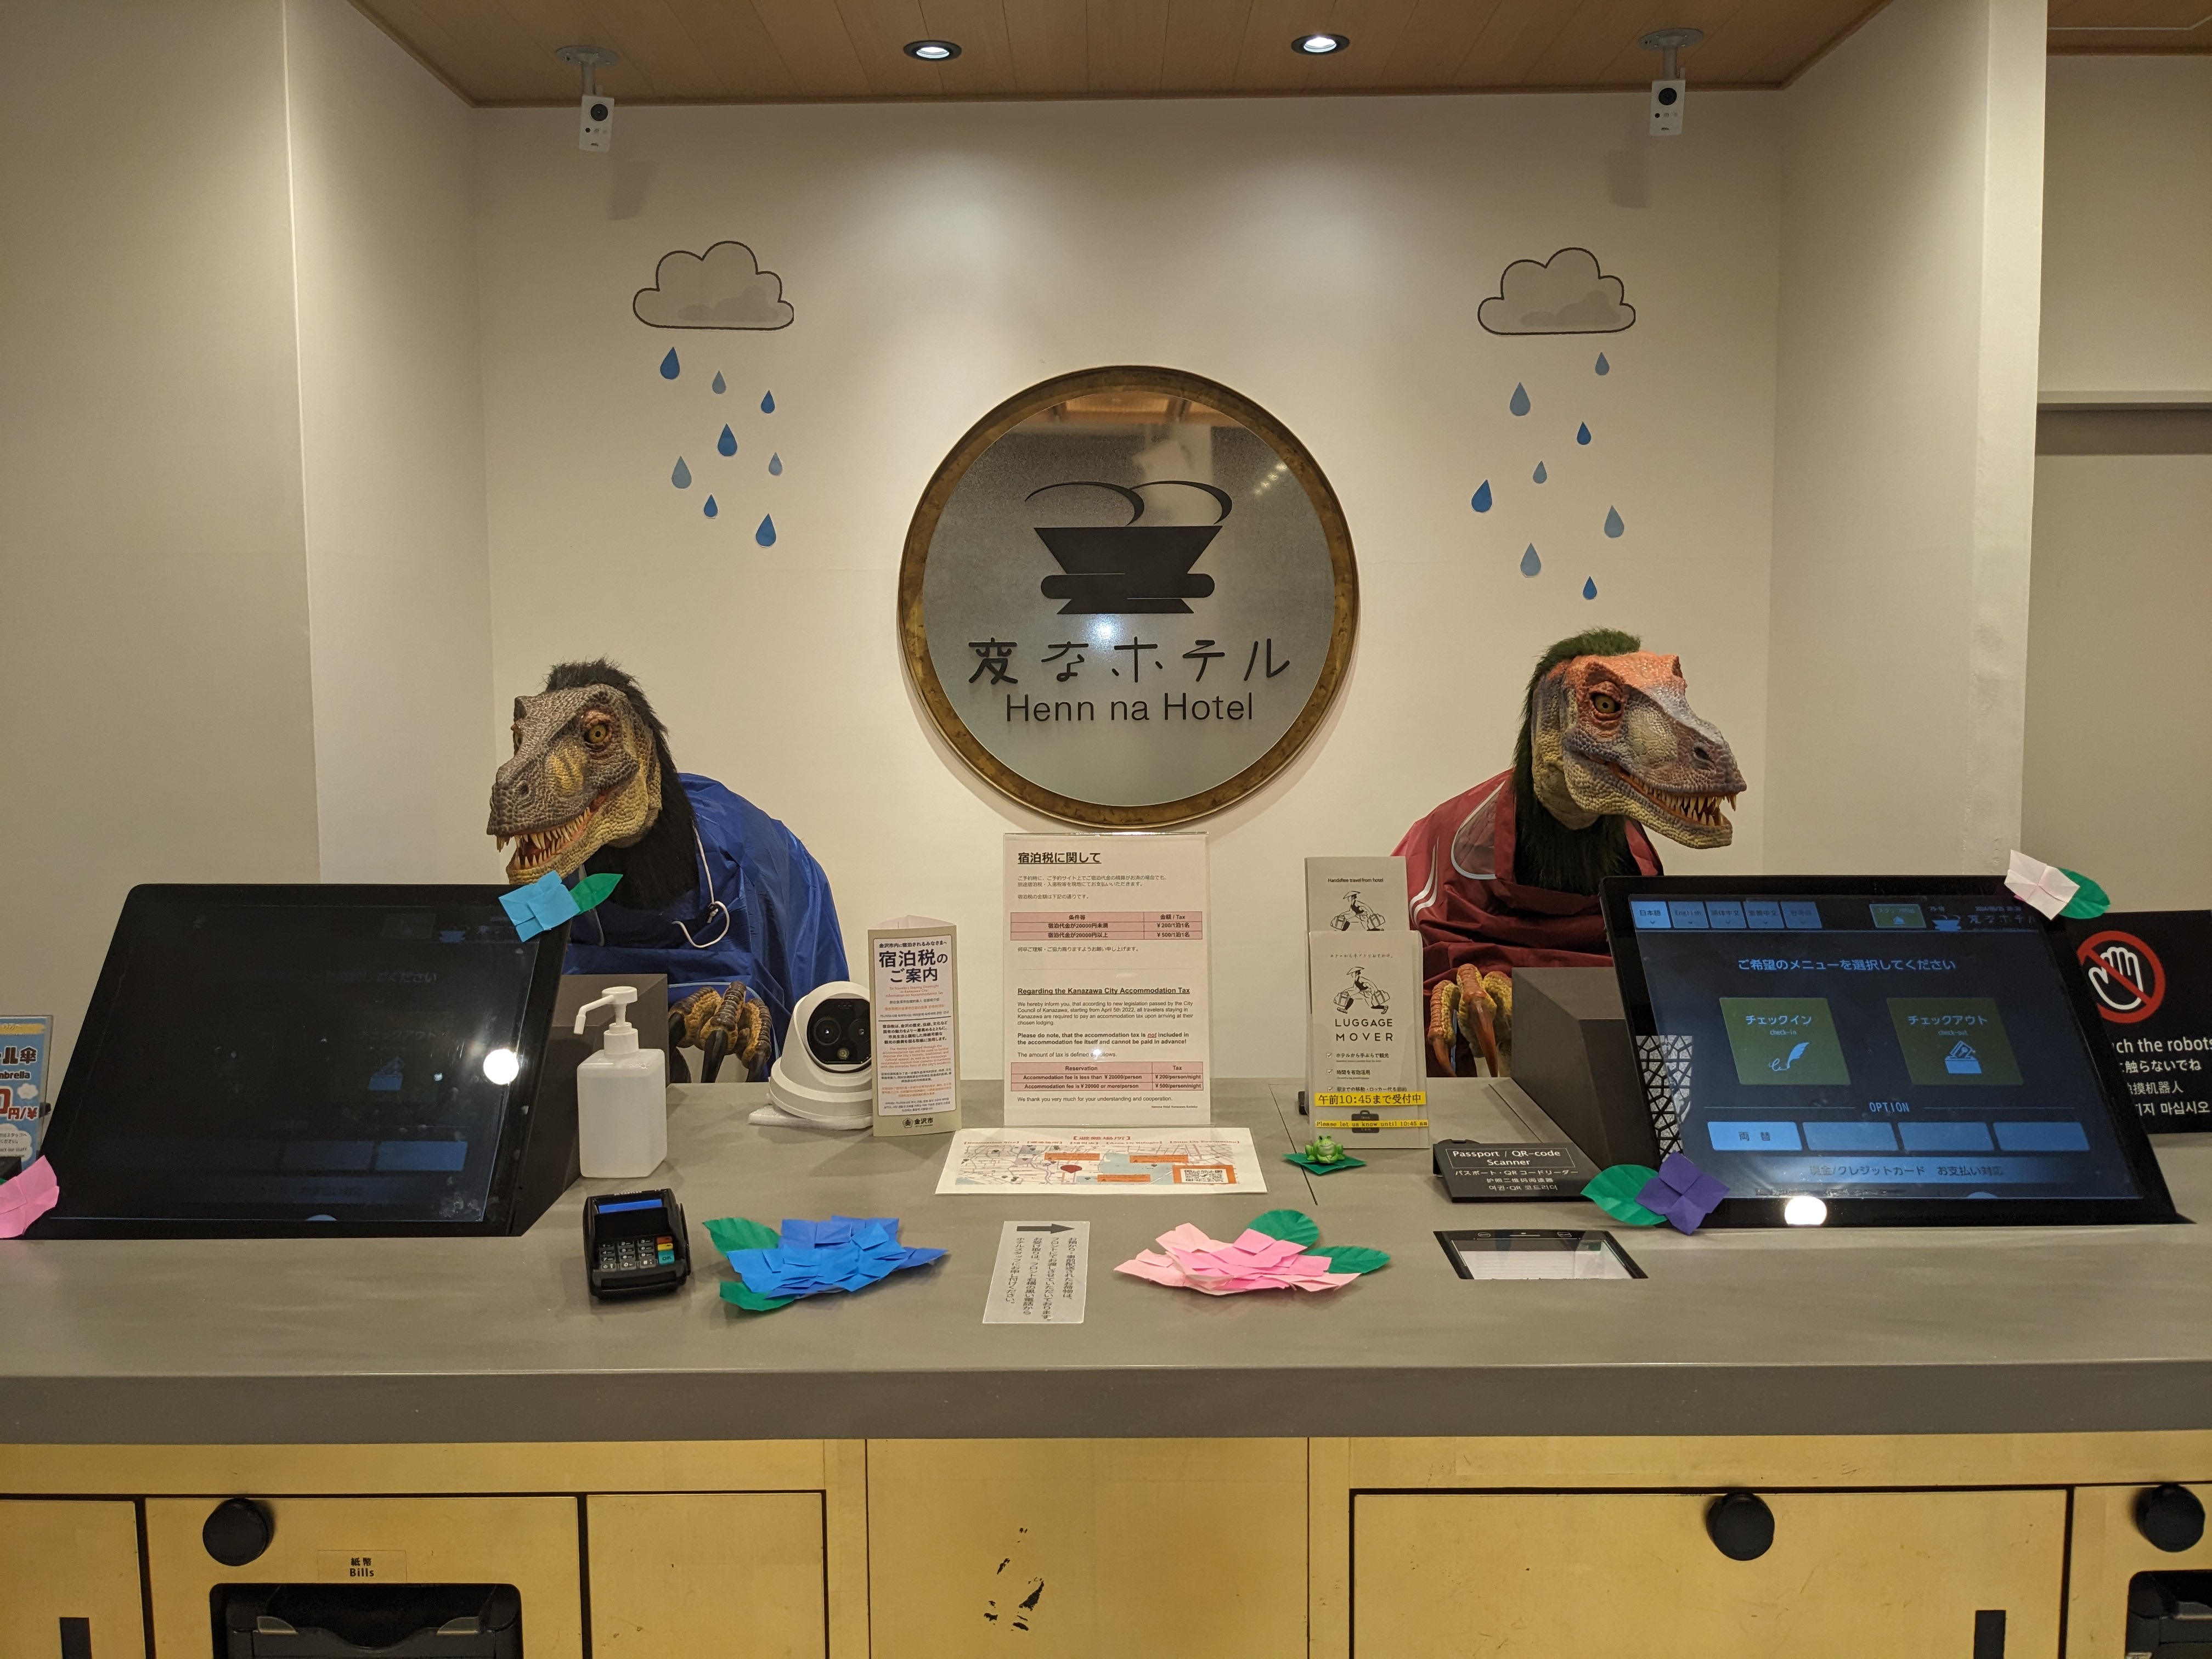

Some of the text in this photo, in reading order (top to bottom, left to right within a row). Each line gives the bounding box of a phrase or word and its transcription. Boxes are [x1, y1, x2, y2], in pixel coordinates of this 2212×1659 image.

[969, 636, 1290, 684] 変なホテル
[1007, 692, 1252, 721] Henn na Hotel
[1018, 852, 1102, 863] 宿泊税に関して
[879, 949, 948, 968] 宿泊税の
[1737, 958, 1956, 972] ご希望のメニューを選択してください
[890, 967, 938, 983] ご案内
[1335, 1018, 1392, 1027] LUGGAGE
[1745, 1014, 1812, 1026] チェックイン
[1908, 1013, 1987, 1026] チェックアウト
[1336, 1032, 1392, 1041] MOVER
[1938, 1029, 1967, 1037] check-out
[2137, 1038, 2163, 1052] the
[2120, 1059, 2202, 1073] 触らないでね
[1318, 1093, 1421, 1105] 午前10:45まで受付中
[1869, 1102, 1910, 1113] OPTION
[2160, 1101, 2210, 1115] 마십시오
[1937, 1165, 2003, 1177] お支払い対応
[351, 1557, 372, 1566] 紙幣
[349, 1568, 375, 1577] Bills
